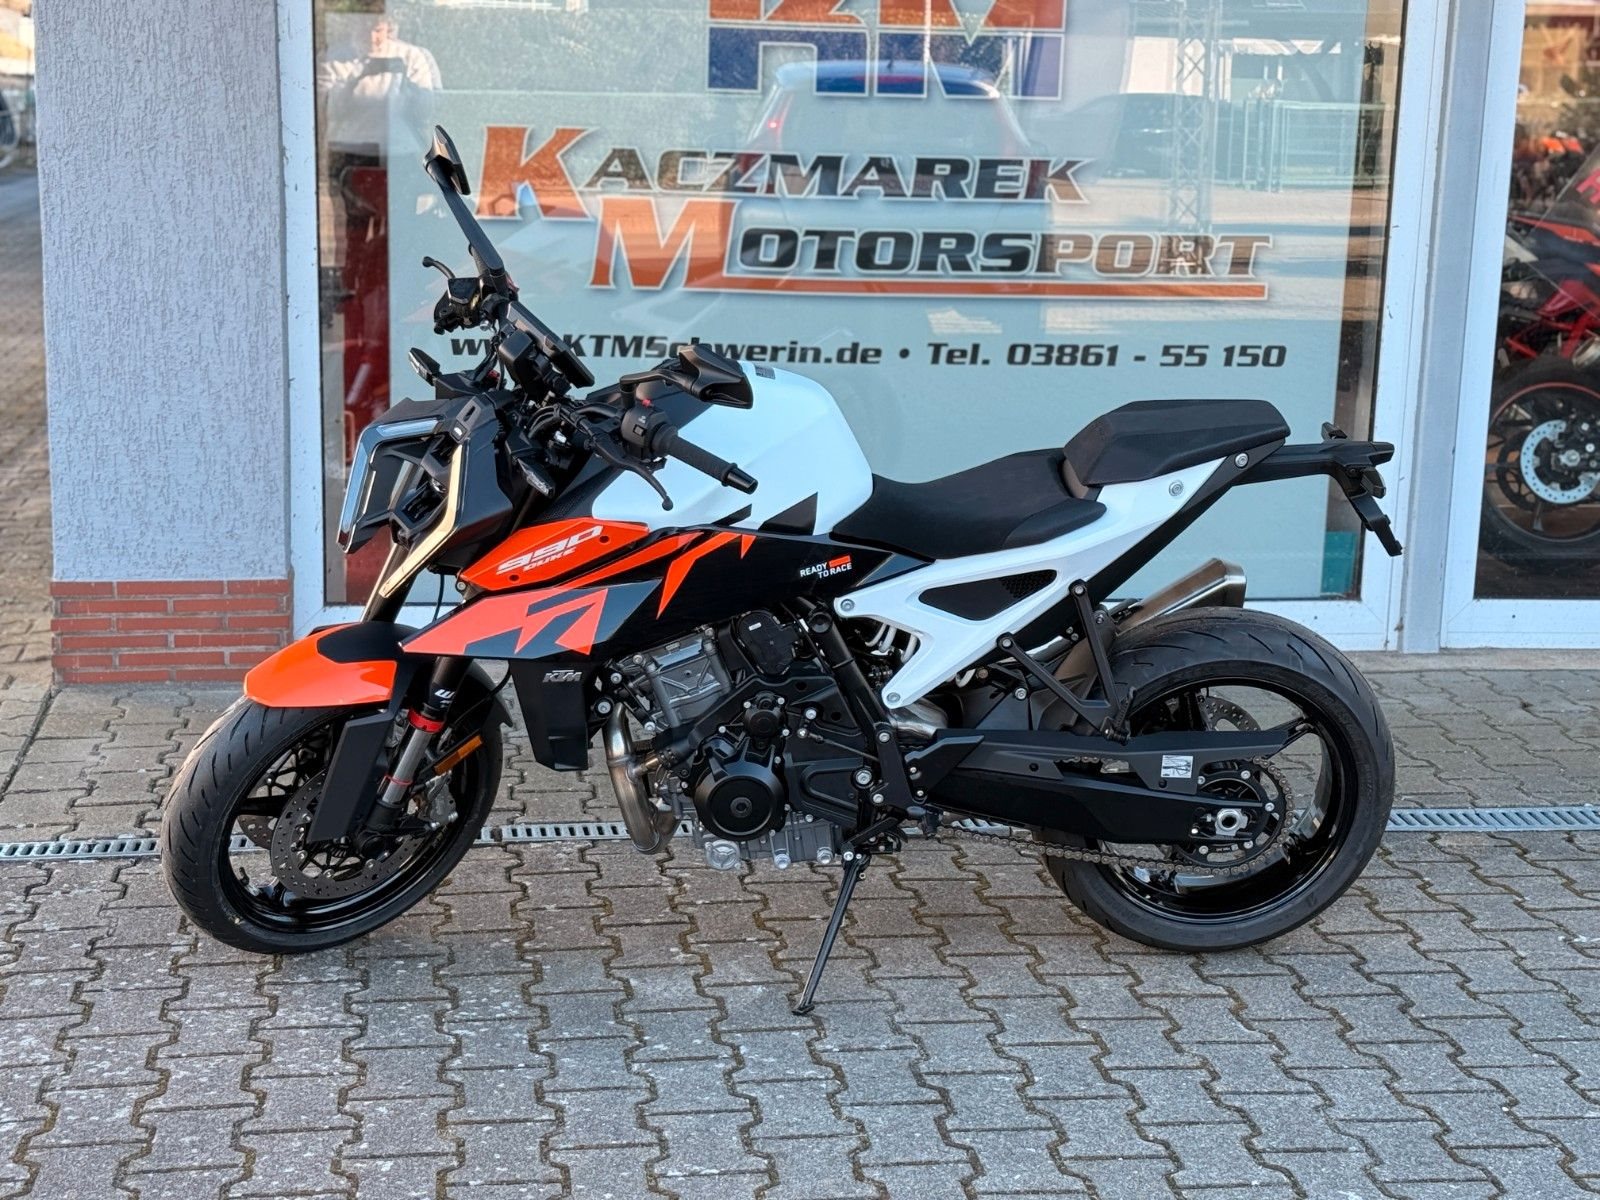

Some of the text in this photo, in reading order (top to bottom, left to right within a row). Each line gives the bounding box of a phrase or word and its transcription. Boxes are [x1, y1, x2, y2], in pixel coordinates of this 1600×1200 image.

[476, 125, 1092, 219] KACZMAREK
[589, 198, 1271, 291] MOTORSPORT
[927, 342, 990, 366] Tel.
[1006, 343, 1119, 367] 03861
[1159, 345, 1209, 367] 55
[1222, 345, 1288, 367] 150
[495, 525, 604, 575] 990
[523, 546, 577, 572] DUKE
[800, 562, 828, 578] READY
[817, 563, 853, 579] TO RACE
[542, 669, 583, 683] KTM
